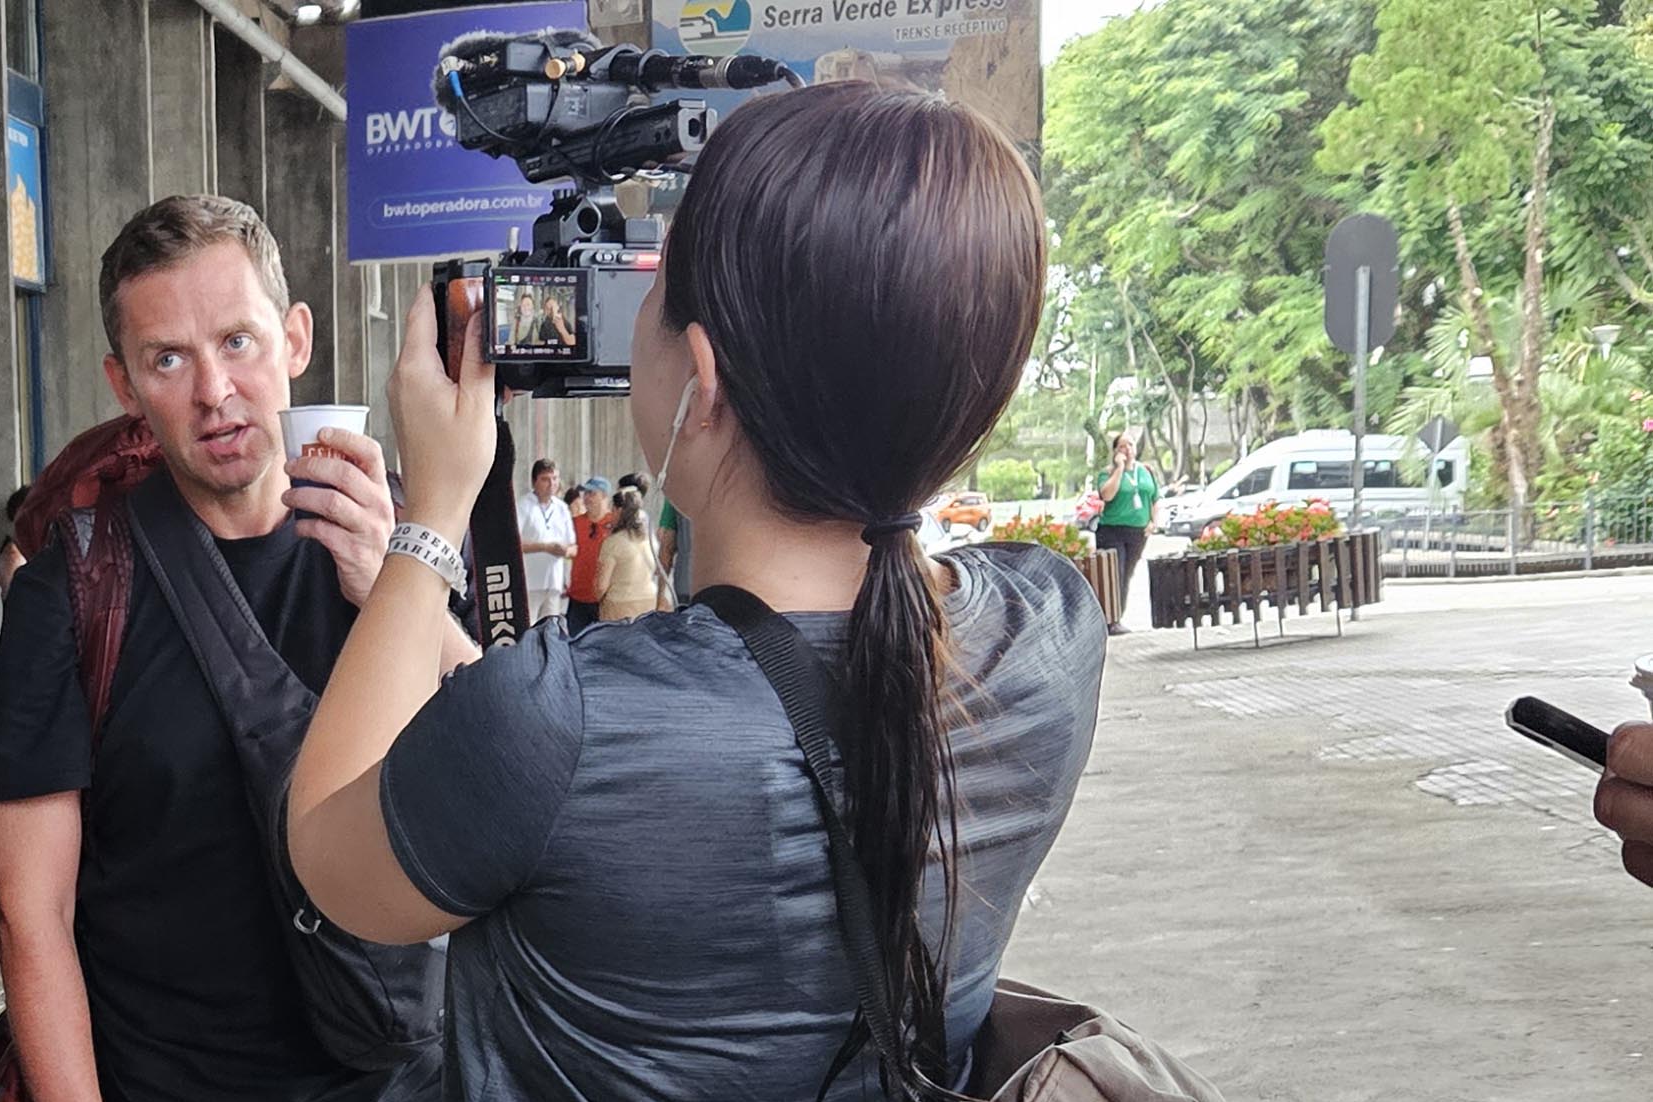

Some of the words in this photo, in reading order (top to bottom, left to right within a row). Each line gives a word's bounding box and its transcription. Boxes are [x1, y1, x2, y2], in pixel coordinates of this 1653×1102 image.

[763, 5, 823, 28] Serra
[832, 0, 897, 21] Verde
[896, 26, 931, 40] TRENS
[934, 25, 942, 37] E
[944, 20, 1006, 36] RECEPTIVO
[366, 107, 438, 145] BWT
[366, 139, 454, 156] OPERADORA
[383, 194, 544, 218] bwtoperadora.com.br
